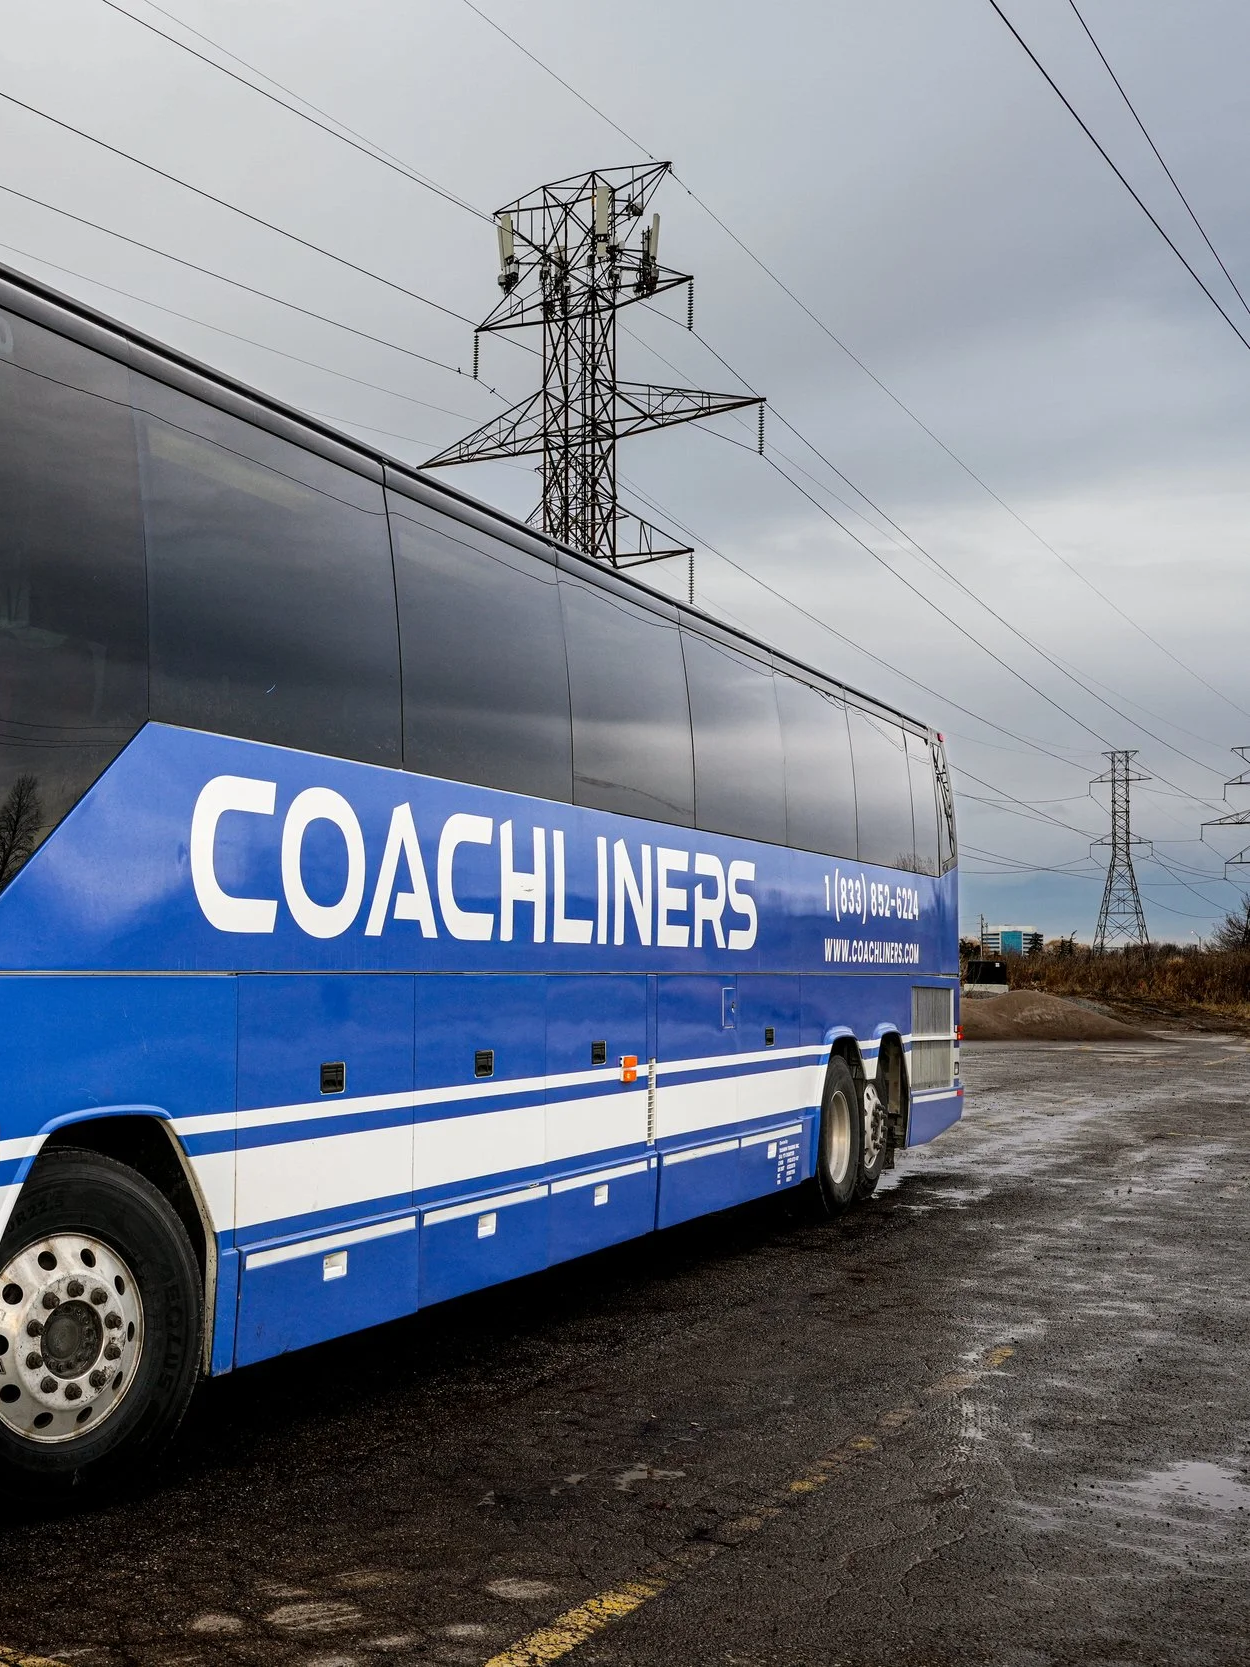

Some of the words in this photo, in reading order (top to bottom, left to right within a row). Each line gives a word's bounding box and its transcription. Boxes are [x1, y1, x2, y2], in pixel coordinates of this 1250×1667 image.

[190, 775, 758, 950] COACHLINERS
[824, 874, 830, 912] 1
[834, 868, 867, 925] (833)
[870, 882, 919, 921] 852-6224
[824, 938, 920, 964] WWW.COACHLINERS.COM
